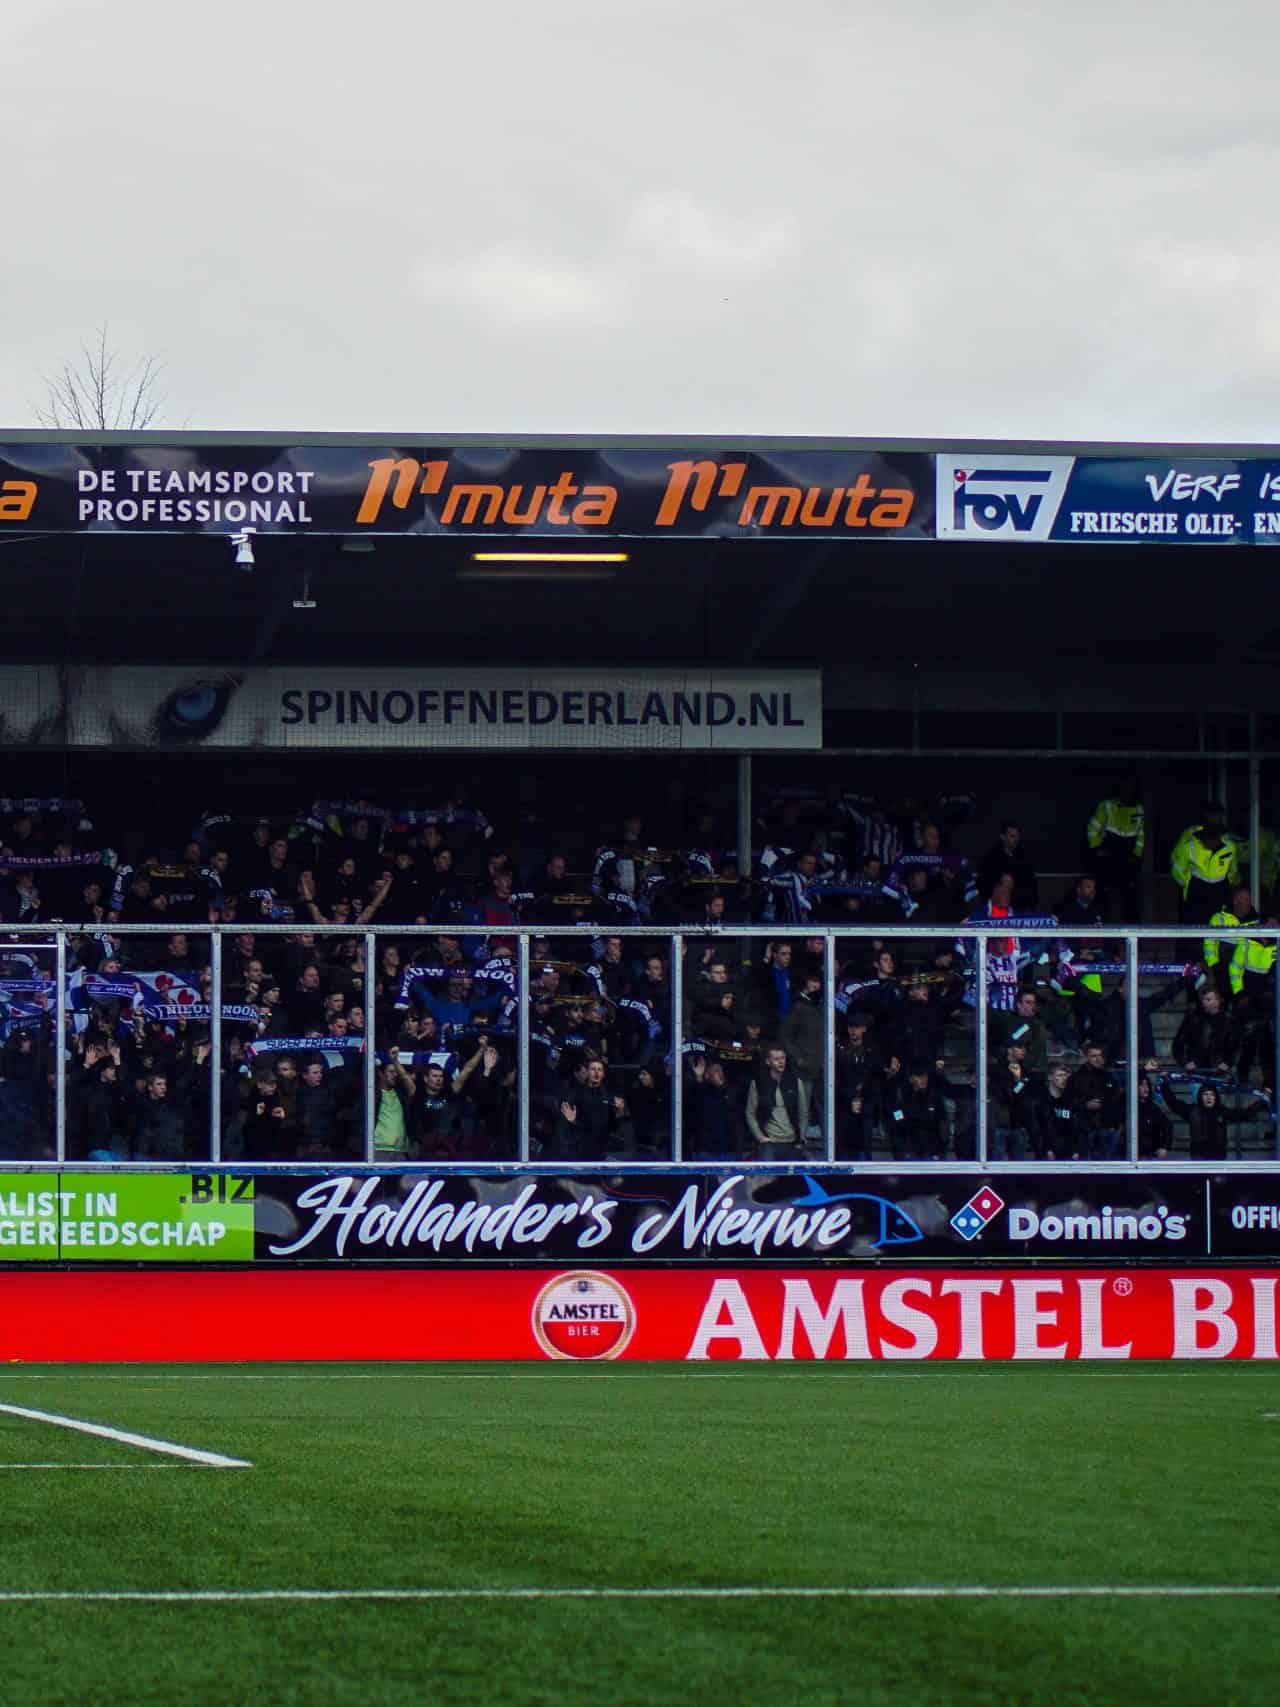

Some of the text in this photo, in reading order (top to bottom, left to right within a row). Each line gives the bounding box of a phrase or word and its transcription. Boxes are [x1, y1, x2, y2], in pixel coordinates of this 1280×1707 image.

[79, 470, 314, 494] DE TEAMSPORT
[1146, 470, 1241, 501] VERF
[440, 471, 617, 526] muta
[739, 473, 915, 528] muta
[79, 499, 312, 528] PROFESSIONAL
[1071, 512, 1178, 534] FRIESCHE
[1185, 513, 1242, 535] OLIE-
[281, 689, 805, 727] SPINOFFNEDERLAND.NL
[85, 1193, 117, 1217] IN
[269, 1175, 851, 1256] Hollander's Nieuwe
[1231, 1206, 1280, 1229] OFFI
[1009, 1206, 1187, 1240] Domino's
[549, 1303, 619, 1319] AMSTEL
[568, 1326, 600, 1336] BIER
